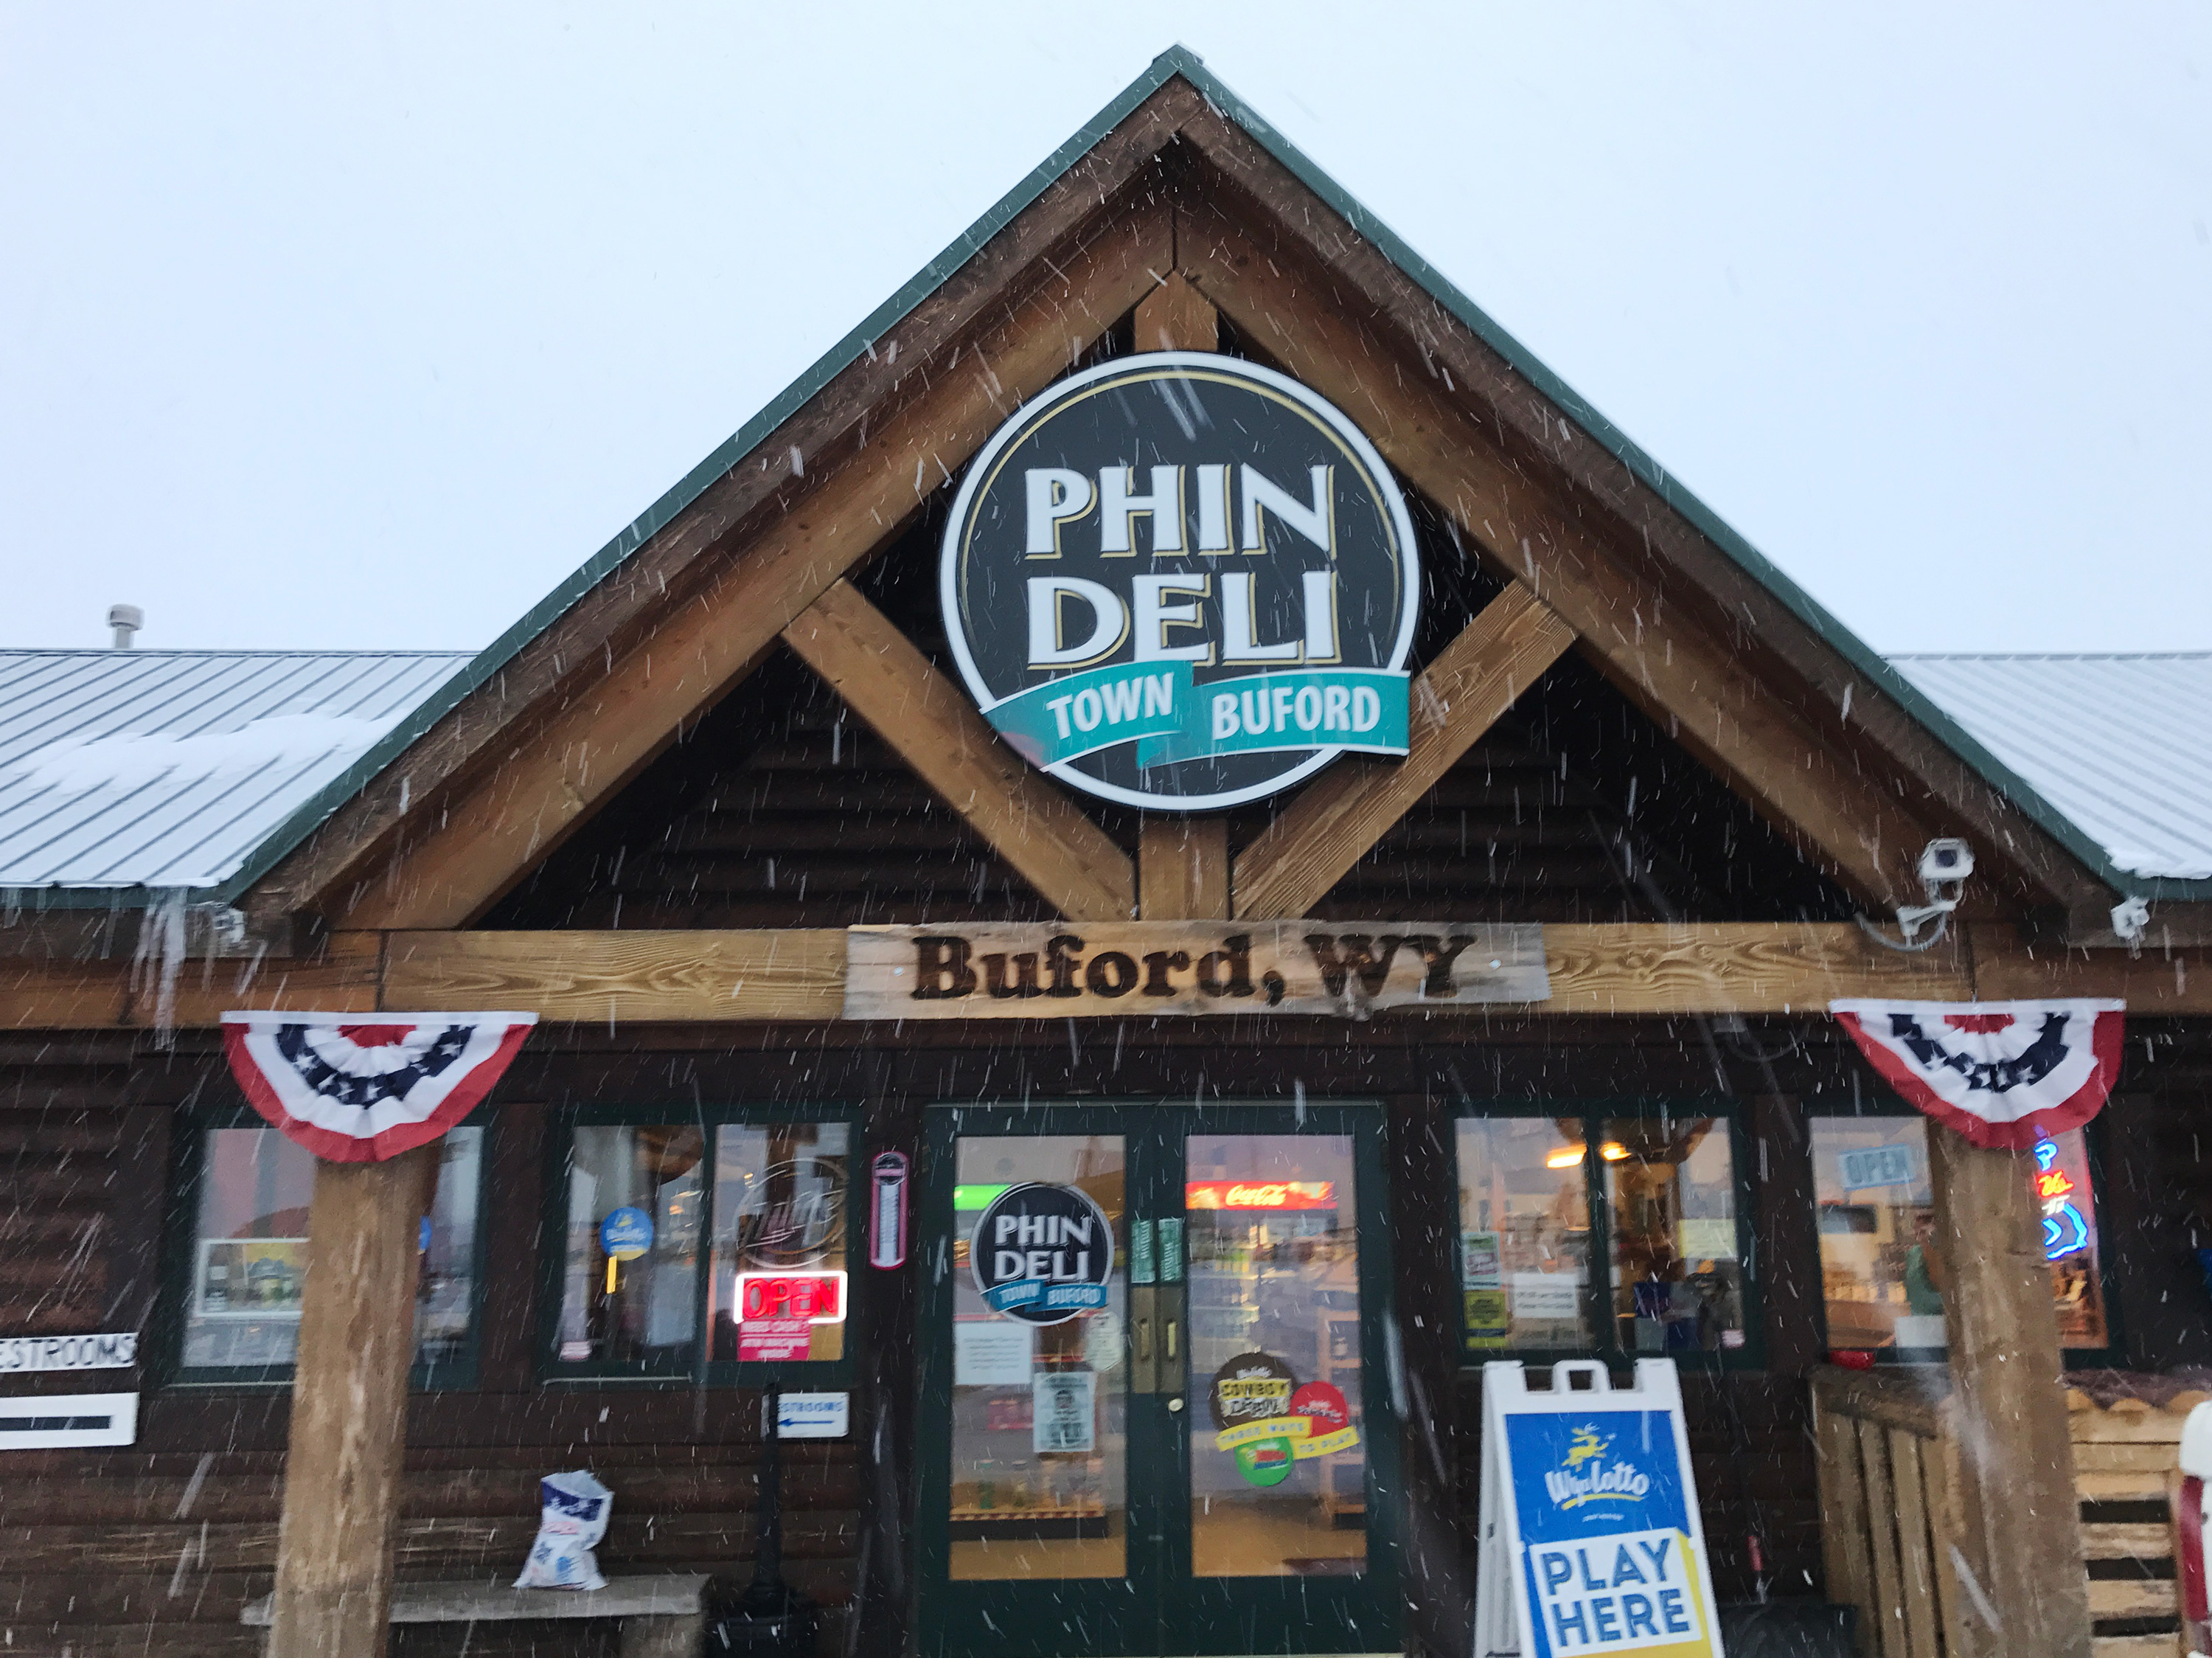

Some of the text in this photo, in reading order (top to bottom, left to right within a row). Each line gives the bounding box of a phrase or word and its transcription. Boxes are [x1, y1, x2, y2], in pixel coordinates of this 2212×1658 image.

[1025, 462, 1337, 559] PHIN
[1026, 570, 1341, 670] DELI
[1046, 671, 1381, 740] TOWN BUFORD
[911, 934, 1478, 1007] Buford, WY
[995, 1215, 1092, 1246] PHIN
[995, 1250, 1090, 1282] DELI
[742, 1277, 840, 1319] OPEN
[1540, 1537, 1671, 1596] PLAY
[1549, 1588, 1690, 1648] HERE
